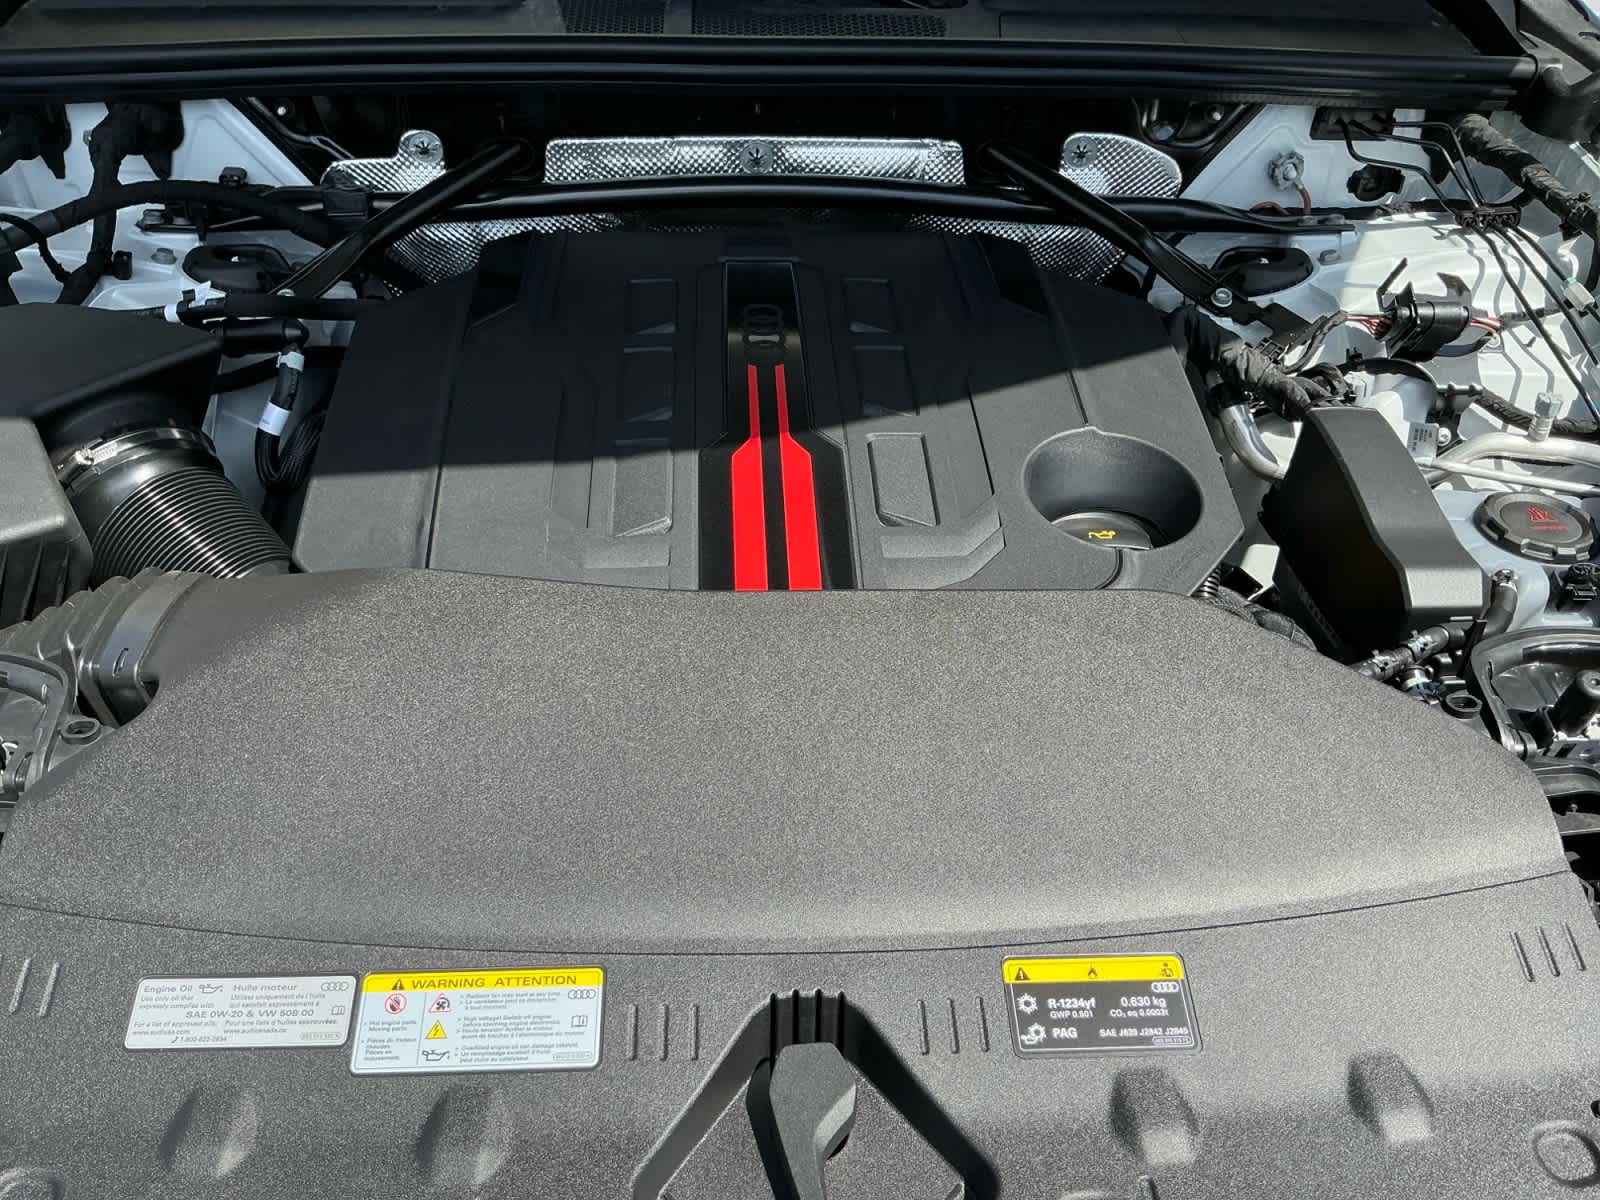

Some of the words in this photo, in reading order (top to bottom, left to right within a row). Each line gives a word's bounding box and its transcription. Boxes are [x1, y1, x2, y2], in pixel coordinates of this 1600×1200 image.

[412, 978, 486, 989] WARNING
[494, 976, 577, 987] ATTENTION
[144, 985, 176, 994] Engine
[179, 984, 193, 993] Oil
[233, 984, 258, 992] Huile
[1047, 996, 1096, 1010] R-1234yf
[1120, 996, 1151, 1007] 0.630
[1152, 995, 1167, 1008] kg
[186, 1010, 207, 1018] SAE
[209, 1009, 243, 1018] 0W-20
[258, 1009, 277, 1017] VW
[1050, 1010, 1071, 1019] GWP
[1127, 1010, 1138, 1018] eq
[1052, 1027, 1078, 1039] PAG
[1099, 1028, 1117, 1037] SAE
